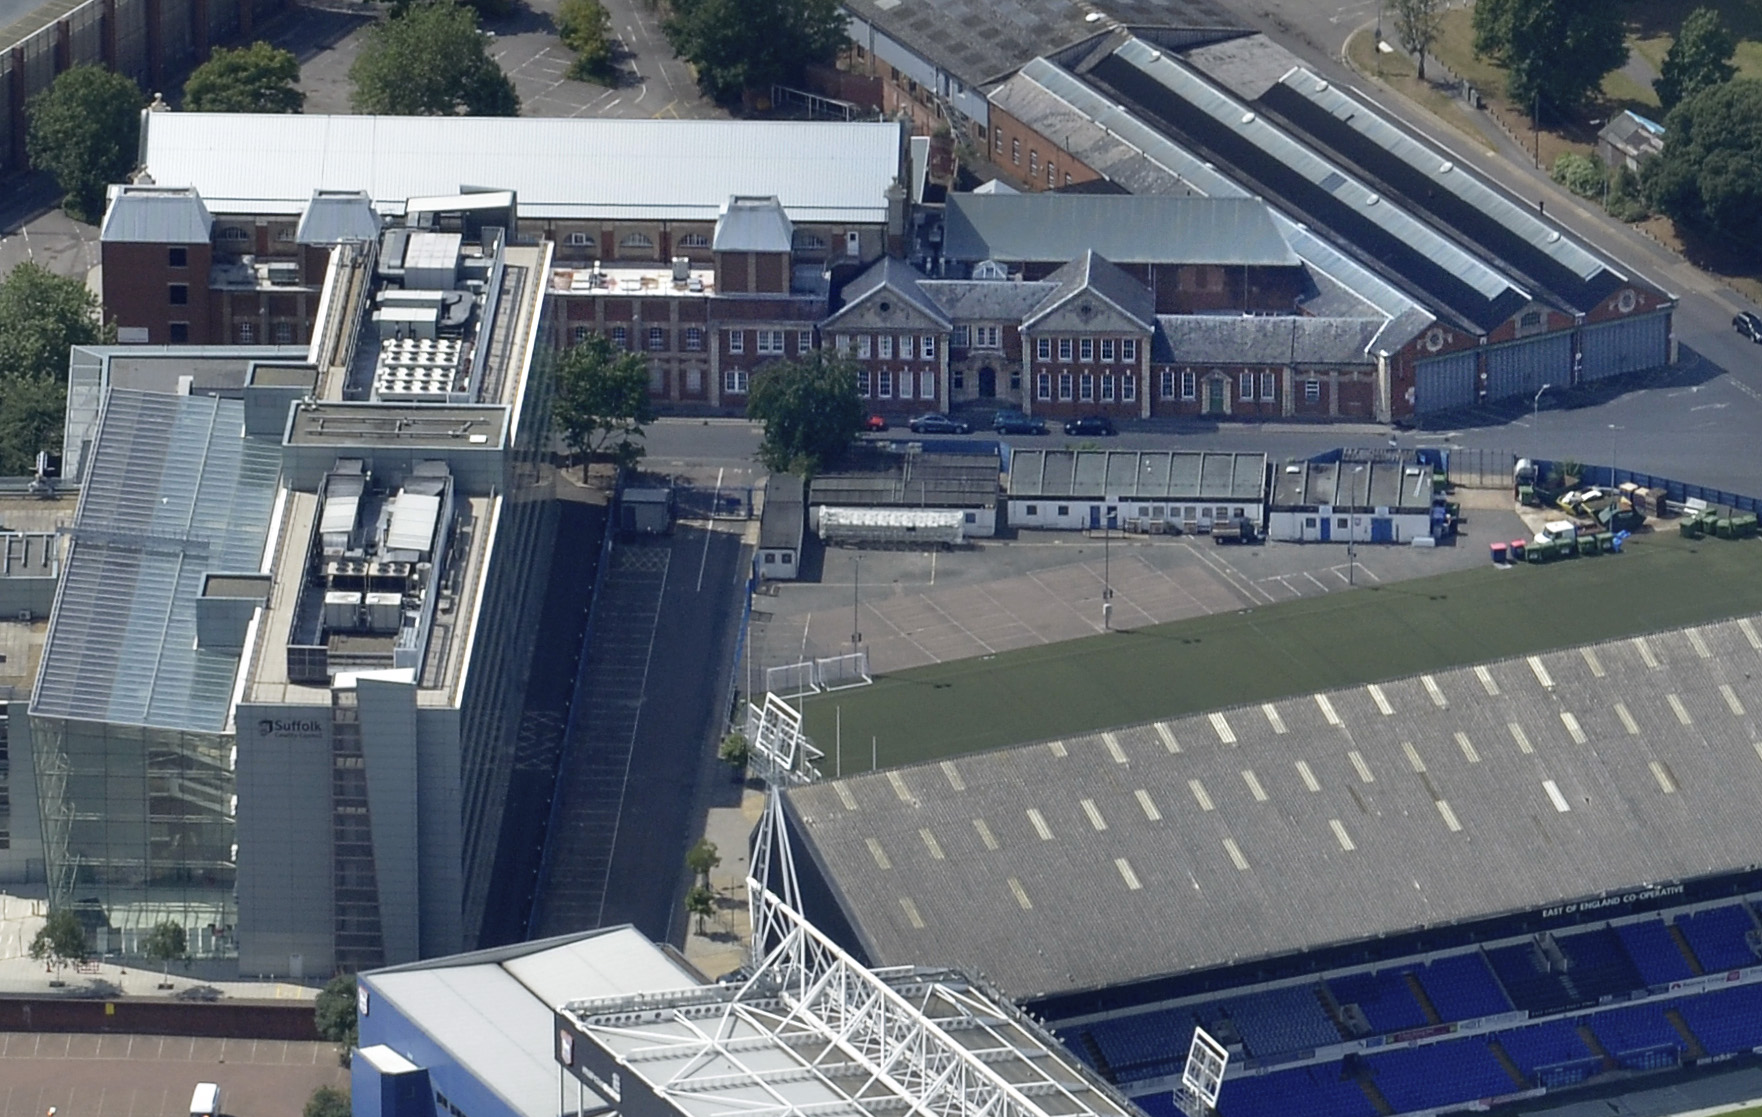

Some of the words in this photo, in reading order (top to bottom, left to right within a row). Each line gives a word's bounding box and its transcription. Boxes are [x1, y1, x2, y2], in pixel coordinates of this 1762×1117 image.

[275, 720, 322, 732] Suffolk
[1542, 908, 1563, 918] EAST
[1566, 905, 1577, 914] OF
[1580, 898, 1620, 911] ENGLAND
